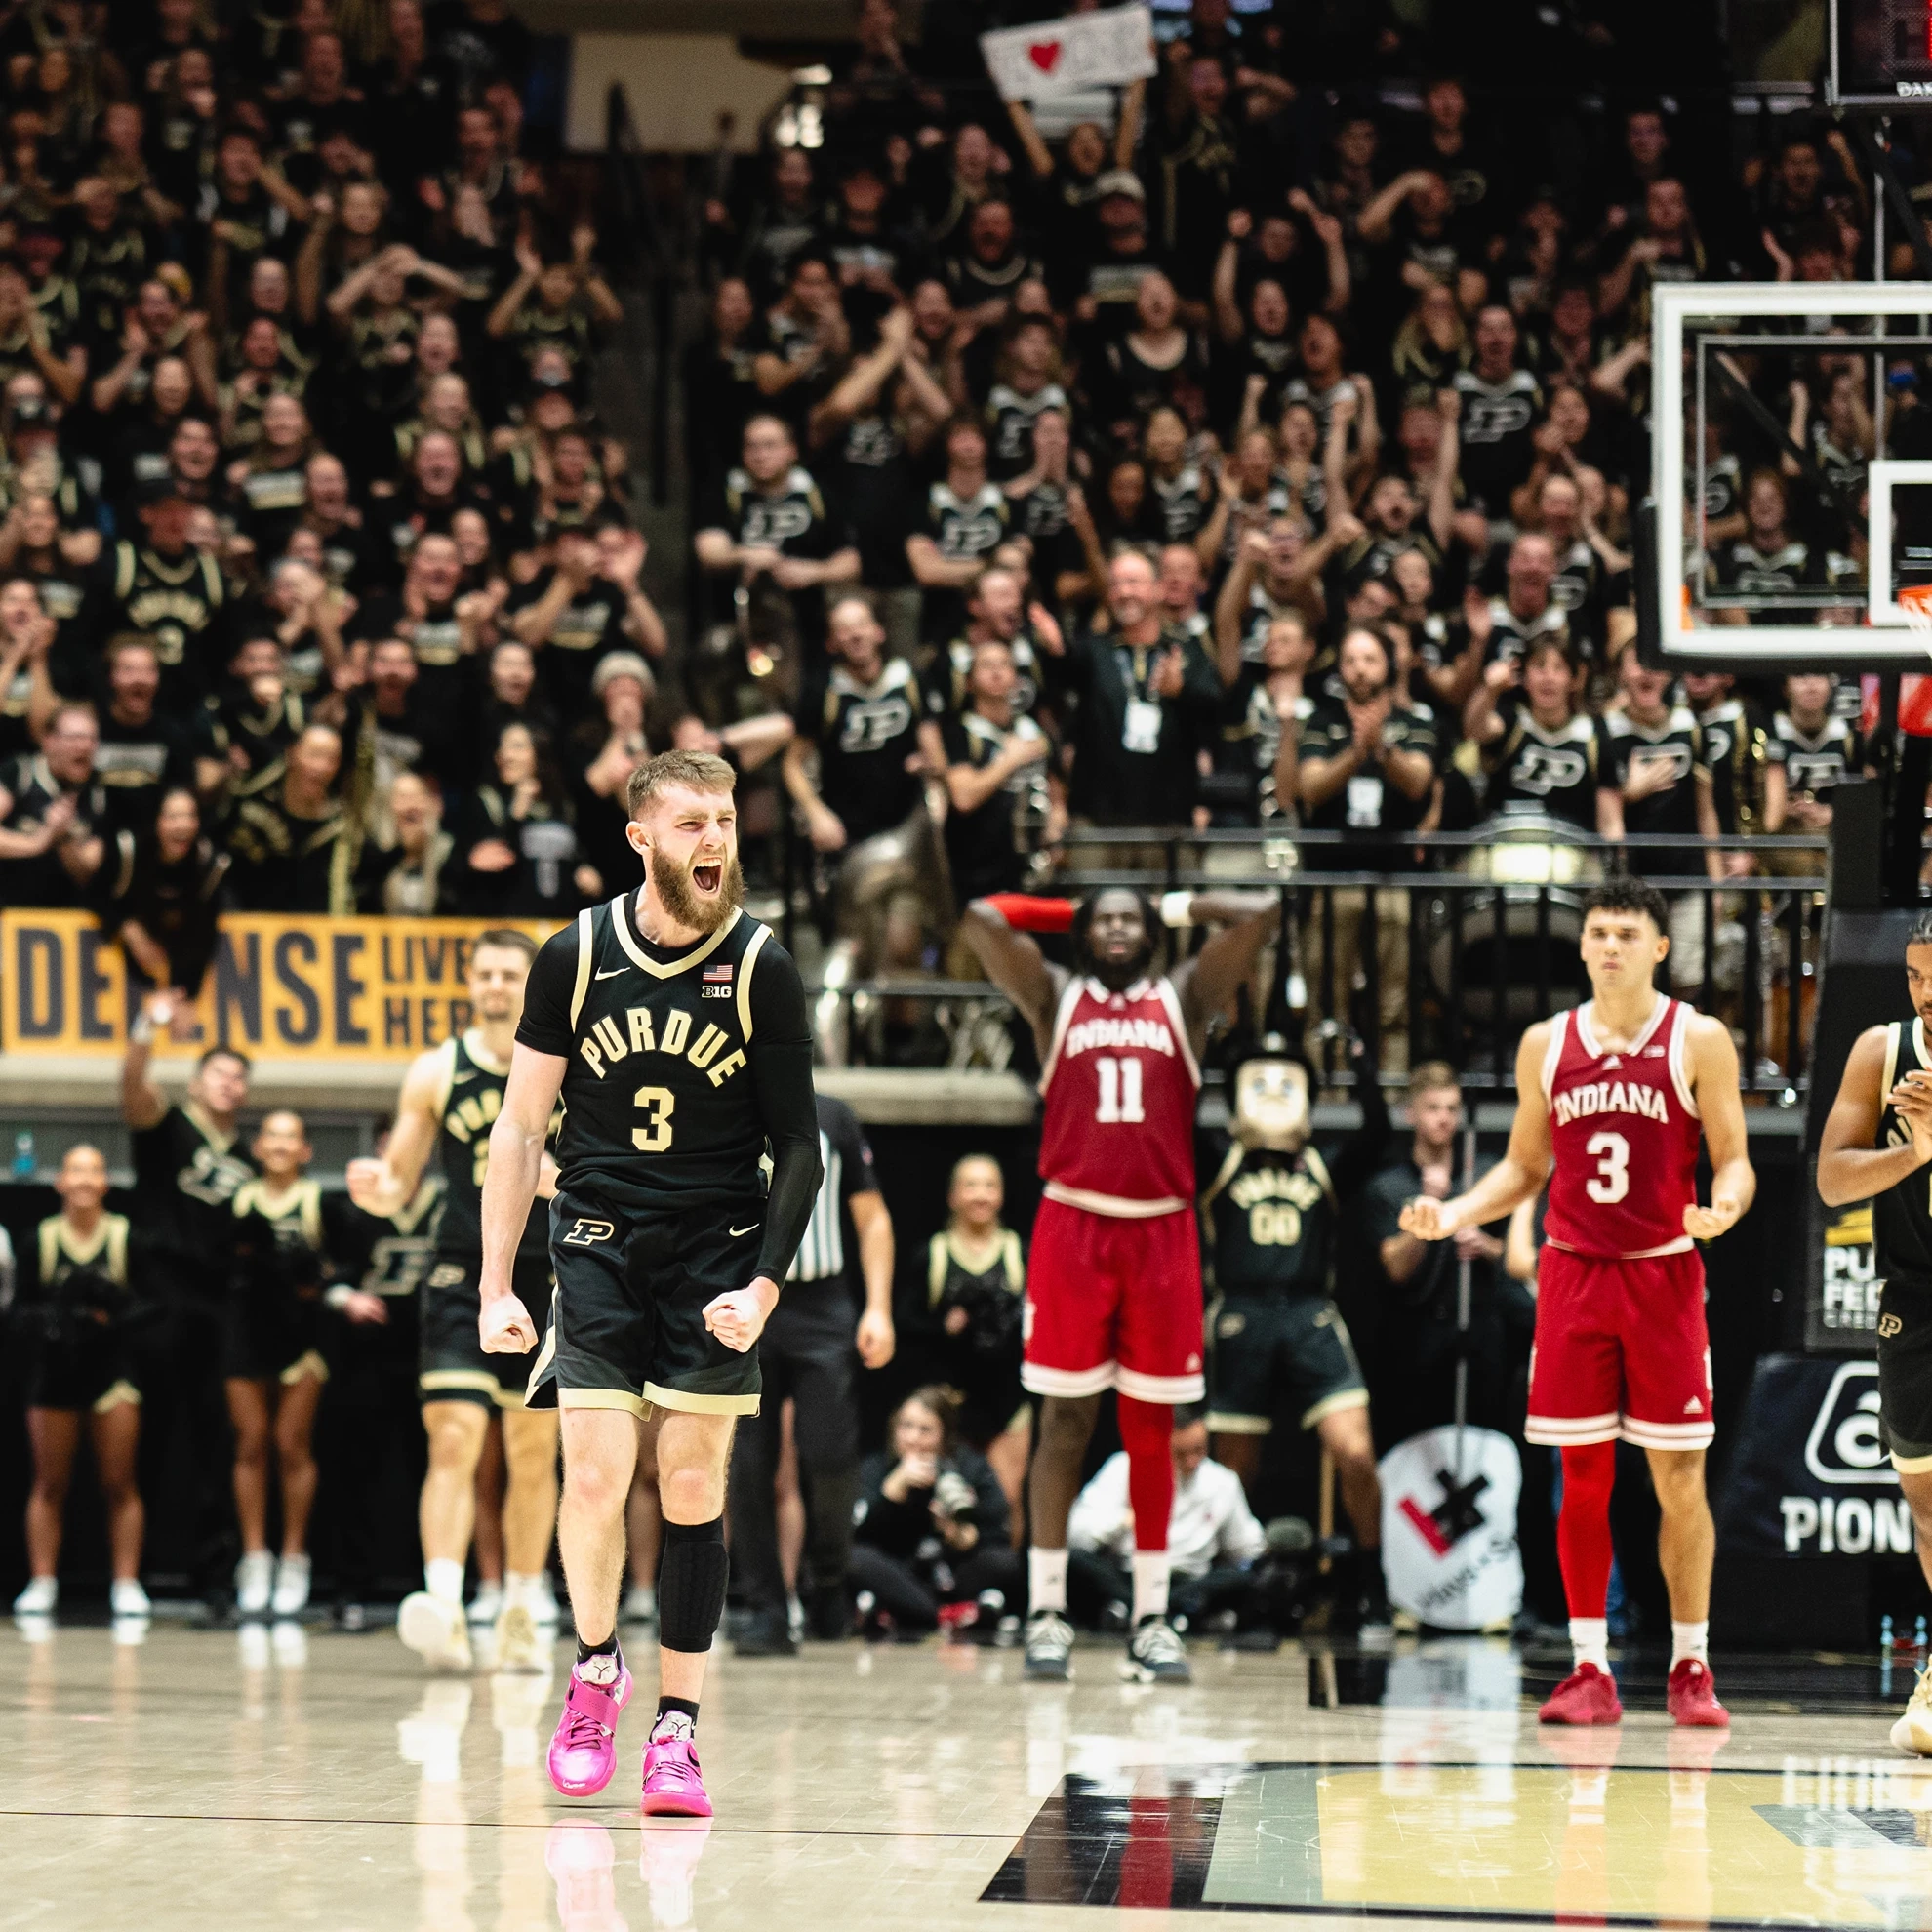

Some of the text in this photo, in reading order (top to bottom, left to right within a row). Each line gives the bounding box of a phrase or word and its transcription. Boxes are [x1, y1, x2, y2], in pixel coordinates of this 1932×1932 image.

[17, 927, 369, 1046] DENSE
[579, 1006, 748, 1089] PURDUE
[1065, 1017, 1176, 1060] INDIANA
[630, 1084, 676, 1153] 3
[1095, 1056, 1146, 1123] 11
[1553, 1080, 1670, 1127] INDIANA
[1586, 1131, 1630, 1204] 3
[562, 1218, 616, 1247] P
[1878, 1311, 1903, 1340] P
[1779, 1495, 1918, 1554] PION
